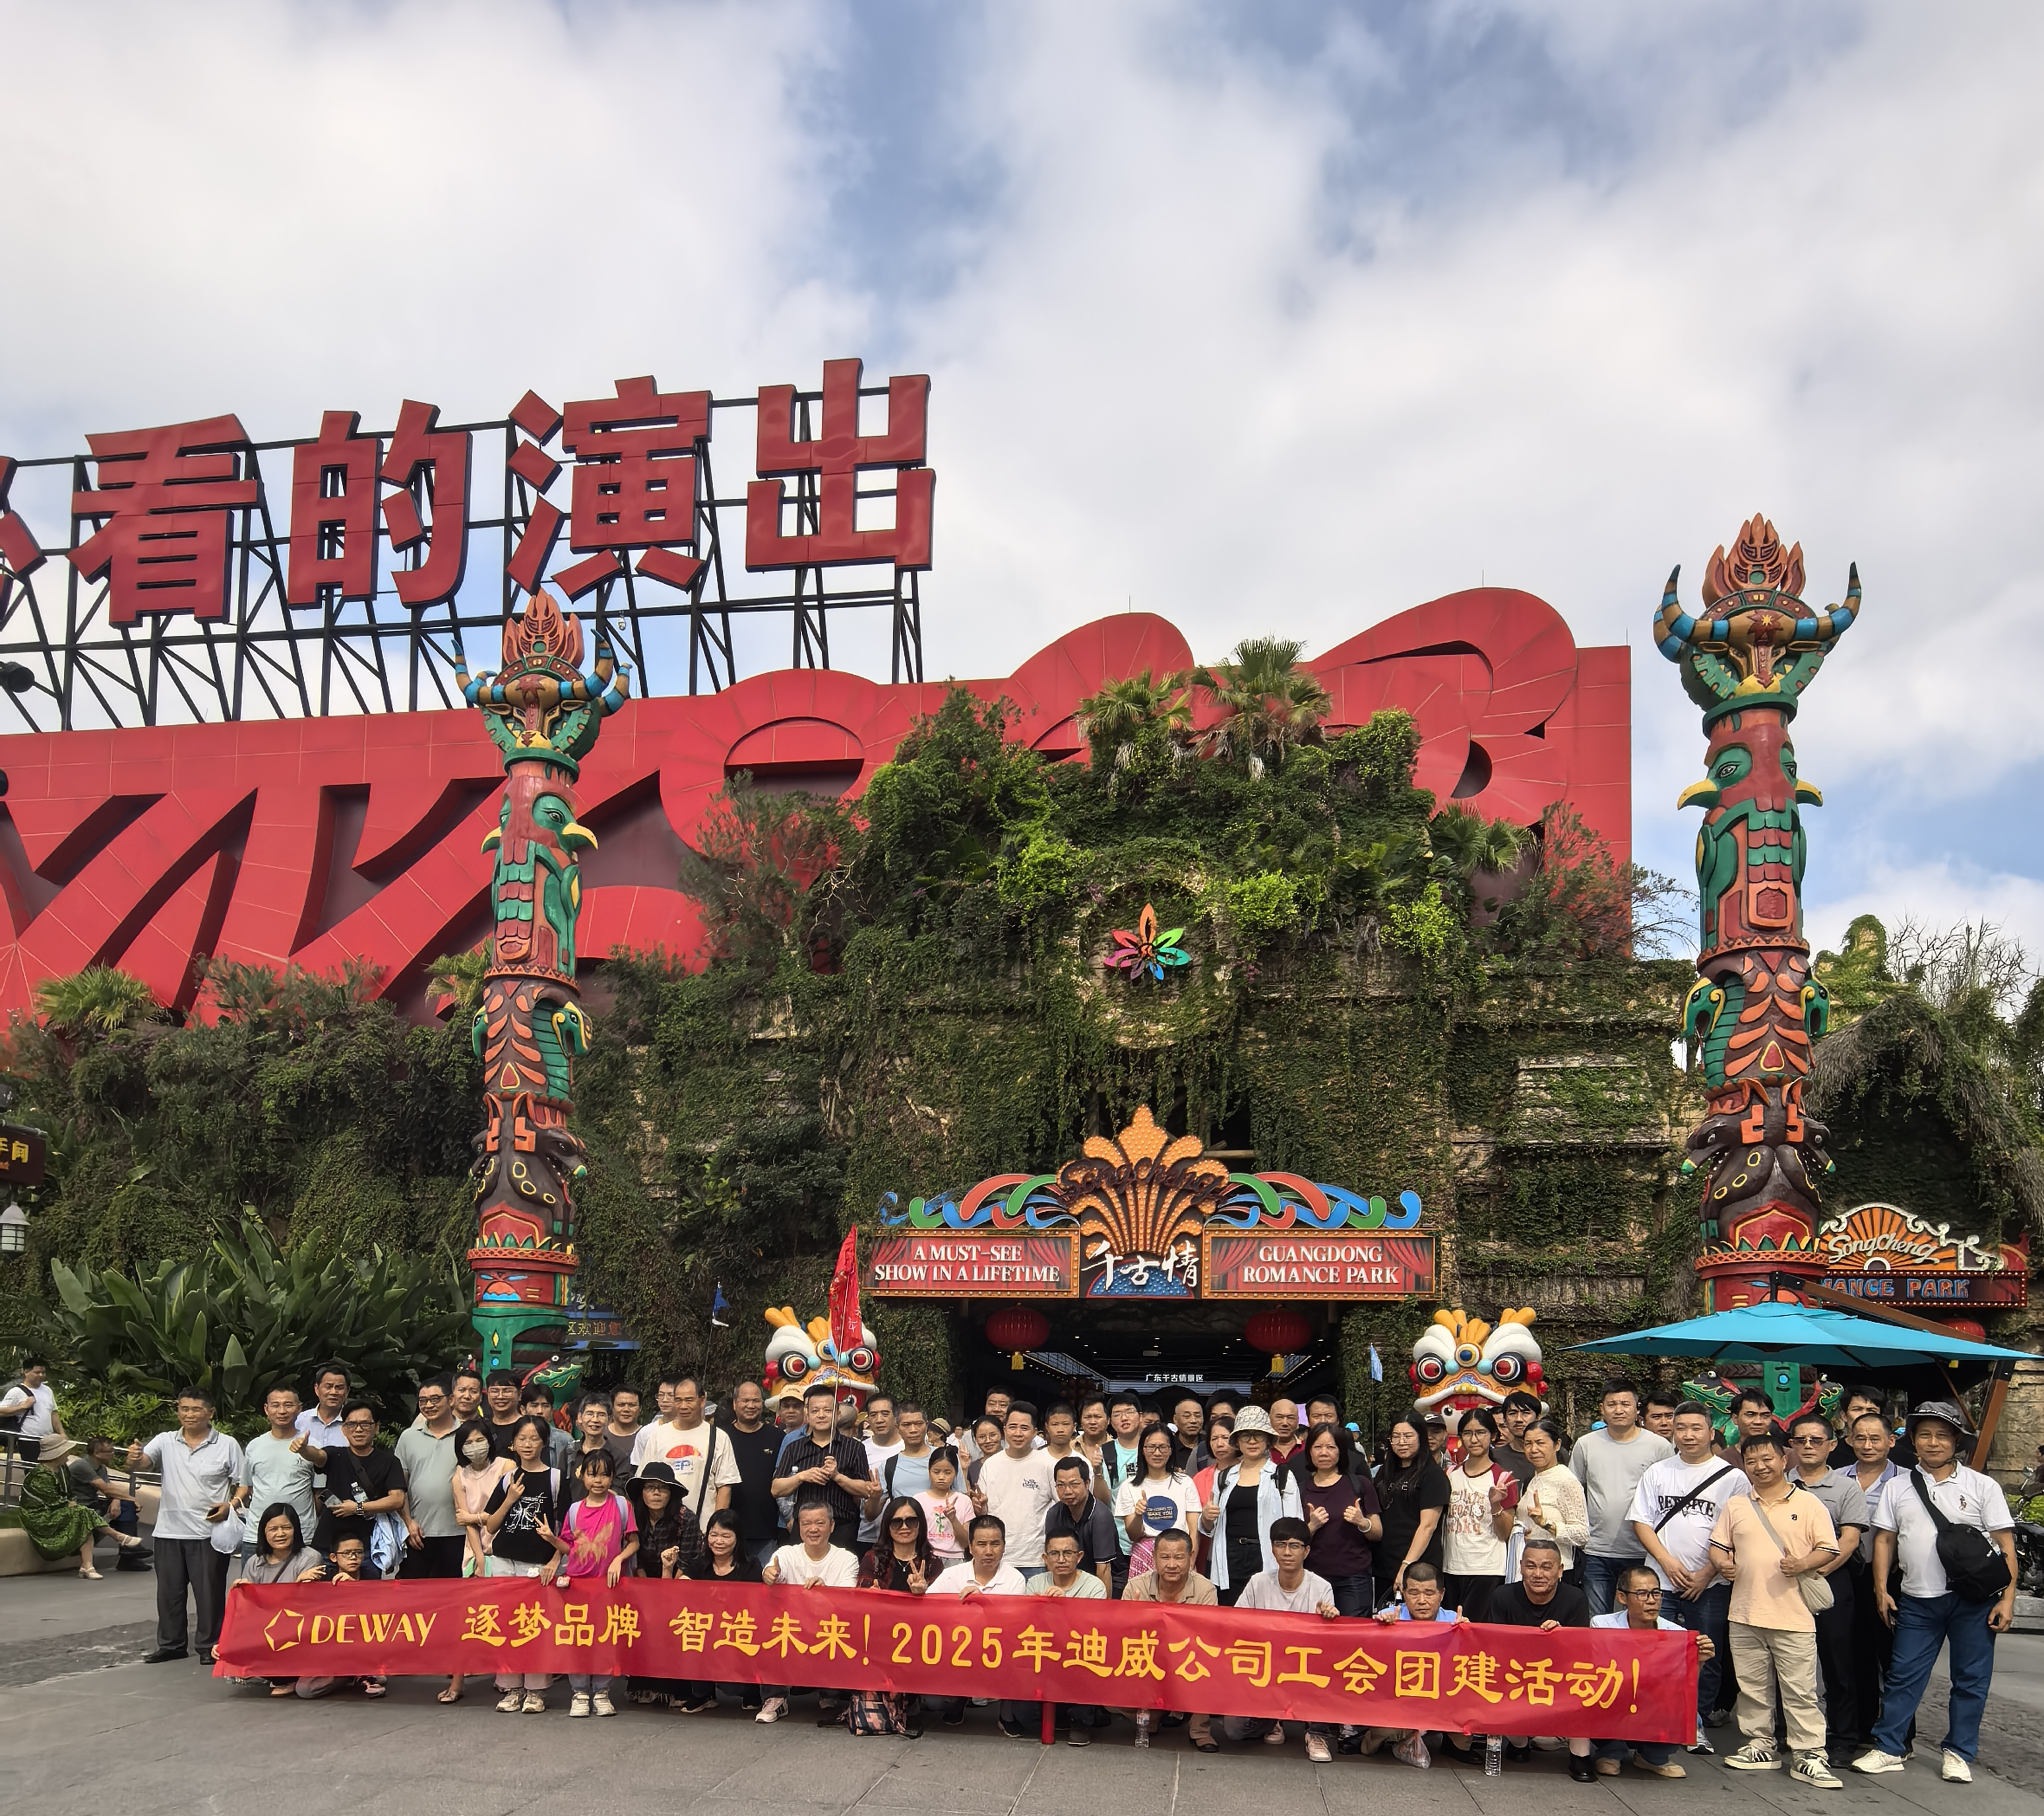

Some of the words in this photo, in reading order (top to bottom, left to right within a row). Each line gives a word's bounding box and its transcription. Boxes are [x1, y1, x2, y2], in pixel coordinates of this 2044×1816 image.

[0, 358, 936, 630] 看的演出
[913, 1244, 927, 1261] A
[929, 1244, 1022, 1262] MUST-SEE
[1259, 1245, 1383, 1263] GUANGDONG
[875, 1264, 929, 1281] SHOW
[932, 1265, 952, 1281] IN
[956, 1266, 970, 1282] A
[972, 1266, 1061, 1282] LIFETIME
[1081, 1239, 1200, 1290] 千古情
[1243, 1265, 1340, 1284] ROMANCE
[1346, 1267, 1400, 1284] PARK
[1907, 1278, 1970, 1298] PARK
[1145, 1373, 1204, 1383] 广东千古情景区
[311, 1613, 437, 1647] DEWAY
[460, 1602, 642, 1648] 逐梦品牌
[669, 1608, 870, 1666] 智造未来!
[891, 1623, 1640, 1714] 2025年迪威公司工会团建活动!
